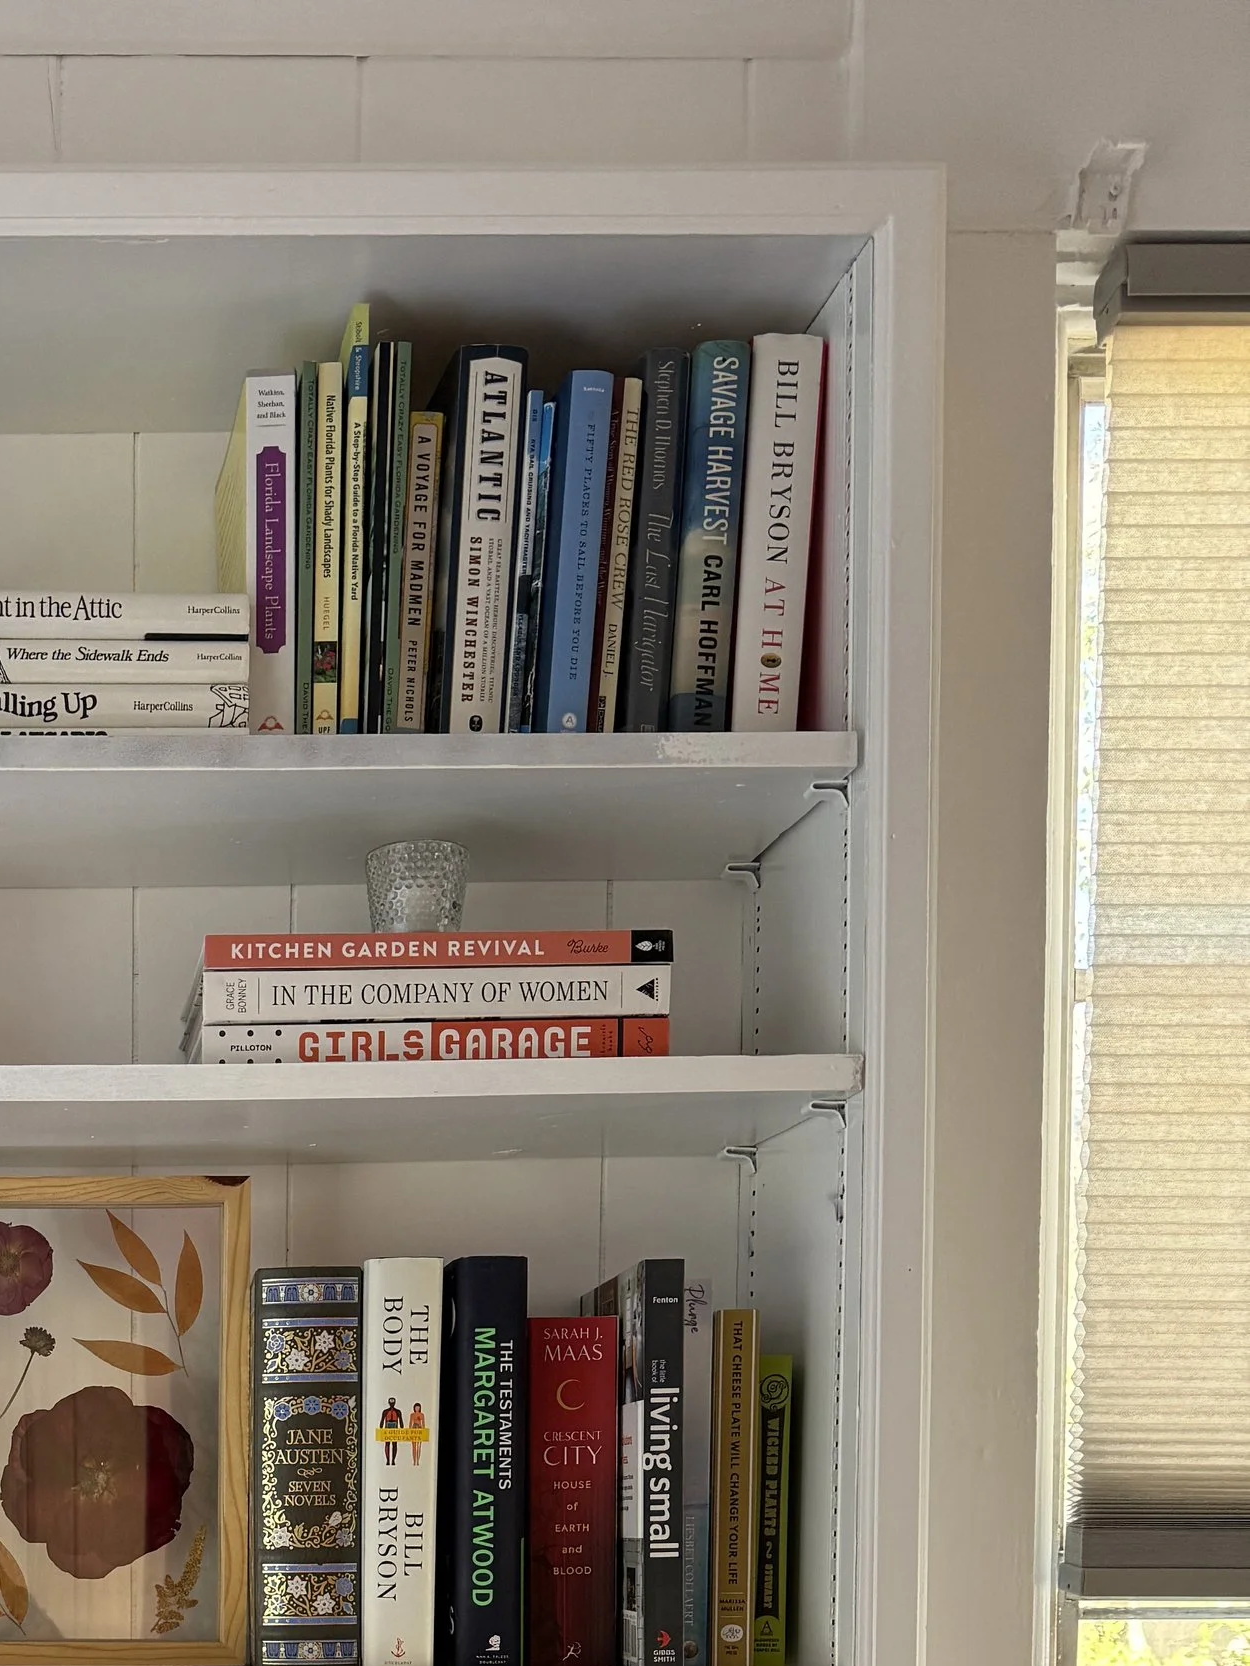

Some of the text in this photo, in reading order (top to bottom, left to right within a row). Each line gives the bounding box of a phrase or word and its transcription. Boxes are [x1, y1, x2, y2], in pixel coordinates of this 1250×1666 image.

[477, 371, 508, 521] ATLANTIC
[321, 395, 336, 578] Native Florida Plants for Shady Landscapes
[407, 436, 431, 626] A VOYAGE FOR MADMEN
[693, 356, 739, 727] SAVAGE HARVEST CARL HOFFMAN
[757, 359, 800, 715] BILL BRYSON AT HOME
[261, 463, 282, 640] Florida Landscape Plants
[569, 424, 596, 680] FIFTY PLACES TO SAIL BEFORE YOU DIE
[322, 596, 330, 630] HUEGEL
[461, 536, 482, 702] SIMON WINCHESTER
[6, 648, 48, 661] Where
[52, 649, 71, 661] the
[75, 646, 133, 662] Sidewalk
[136, 649, 169, 663] Ends
[197, 653, 242, 662] HarperCollins
[404, 640, 418, 722] PETER NICHOLS
[64, 692, 97, 720] Up
[133, 701, 193, 713] HarperCollins
[231, 938, 609, 959] KITCHEN GARDEN REVIVAL Burke
[225, 981, 235, 1010] GRACE
[237, 978, 247, 1014] BONNEY
[272, 981, 608, 1006] IN THE COMPANY OF WOMEN
[230, 1044, 272, 1052] PILLOTON
[299, 1030, 424, 1063] GIRLS
[438, 1026, 592, 1060] GARAGE
[382, 1296, 404, 1375] BODY
[410, 1305, 430, 1365] THE
[543, 1328, 604, 1341] SARAH J.
[544, 1344, 603, 1362] MAAS
[498, 1340, 514, 1490] THE TESTAMENTS
[285, 1429, 333, 1446] JANE
[544, 1431, 602, 1442] CRESCENT
[728, 1321, 743, 1585] THAT CHEESE PLATE WILL CHANGE YOUR LIFE
[275, 1448, 344, 1465] AUSTEN
[472, 1328, 497, 1606] MARGARET ATWOOD
[544, 1445, 602, 1466] CITY
[643, 1387, 680, 1558] living small
[283, 1494, 336, 1508] NOVELS
[288, 1481, 331, 1493] SEVEN
[553, 1480, 591, 1490] HOUSE
[566, 1501, 578, 1512] of
[377, 1487, 399, 1601] BRYSON
[404, 1512, 424, 1576] BILL
[554, 1523, 590, 1533] EARTH
[561, 1544, 582, 1555] and
[553, 1566, 592, 1575] BLOOD
